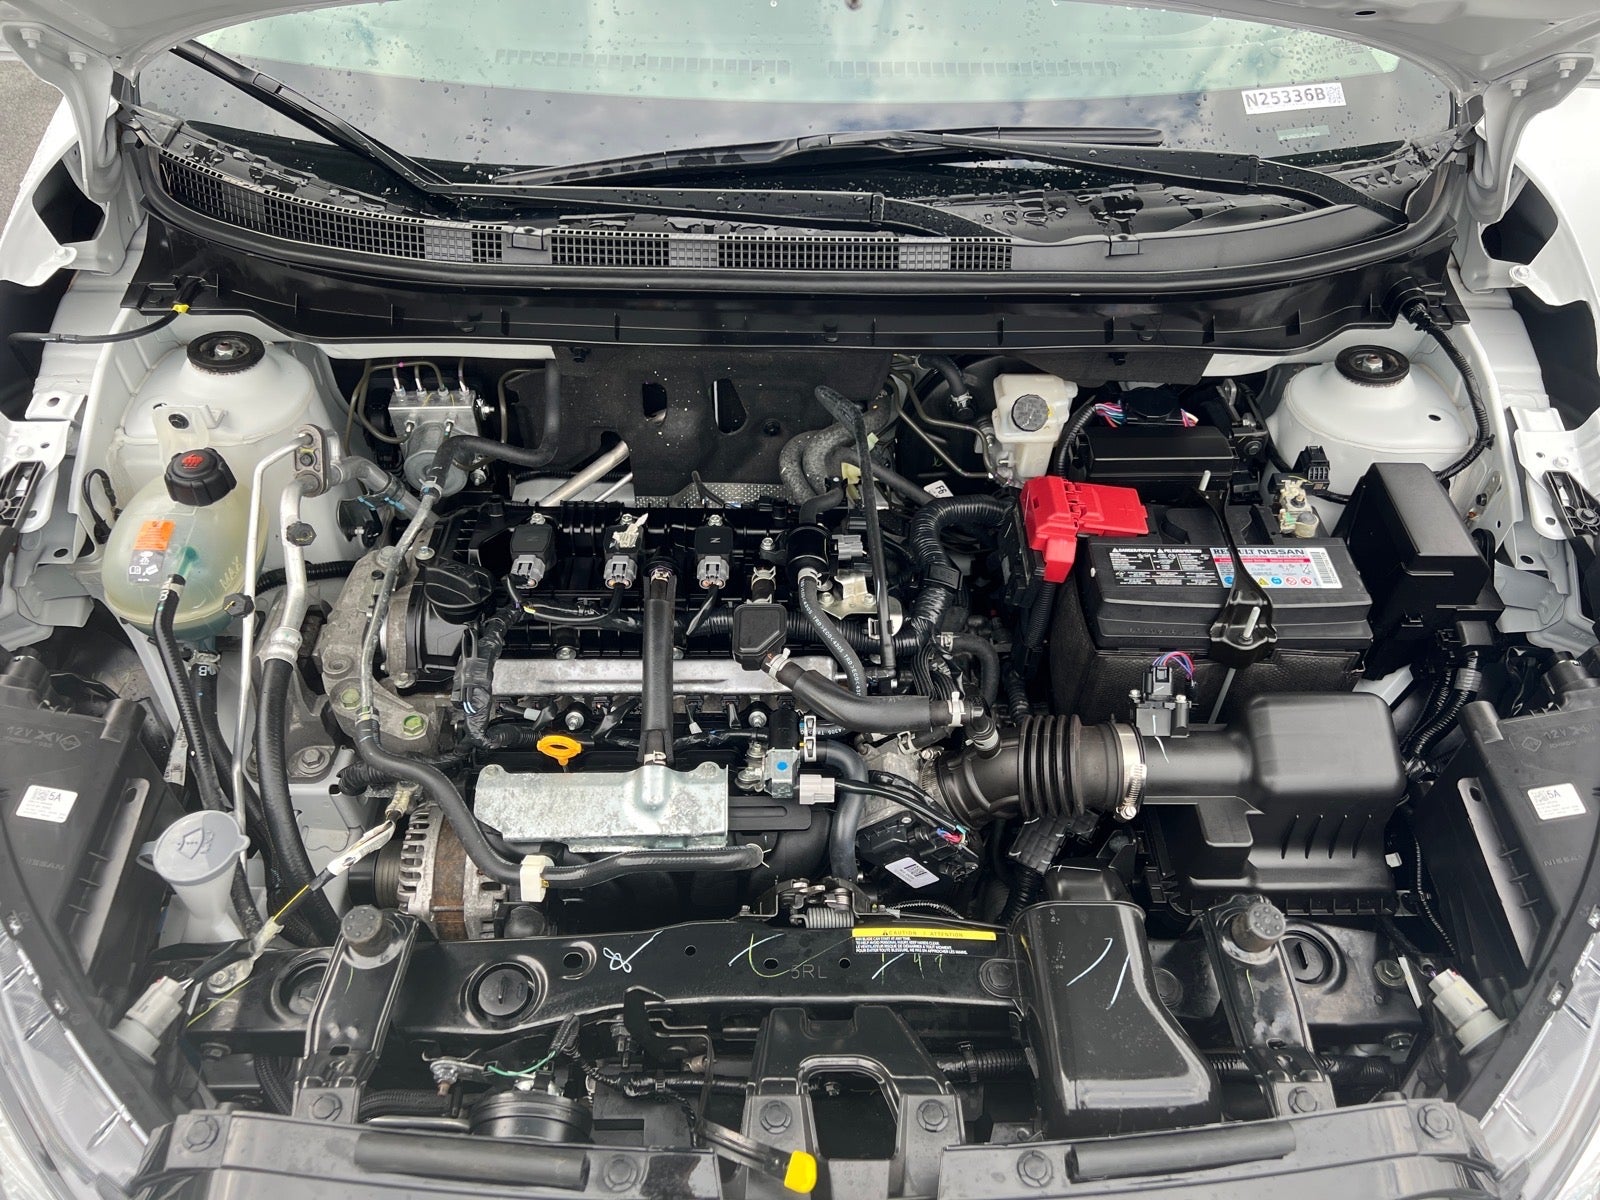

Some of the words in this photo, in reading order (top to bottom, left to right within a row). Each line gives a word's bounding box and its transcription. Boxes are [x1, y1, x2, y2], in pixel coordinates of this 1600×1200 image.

[1245, 87, 1326, 108] N25336B
[48, 791, 62, 802] 5A
[1546, 789, 1561, 799] 5A
